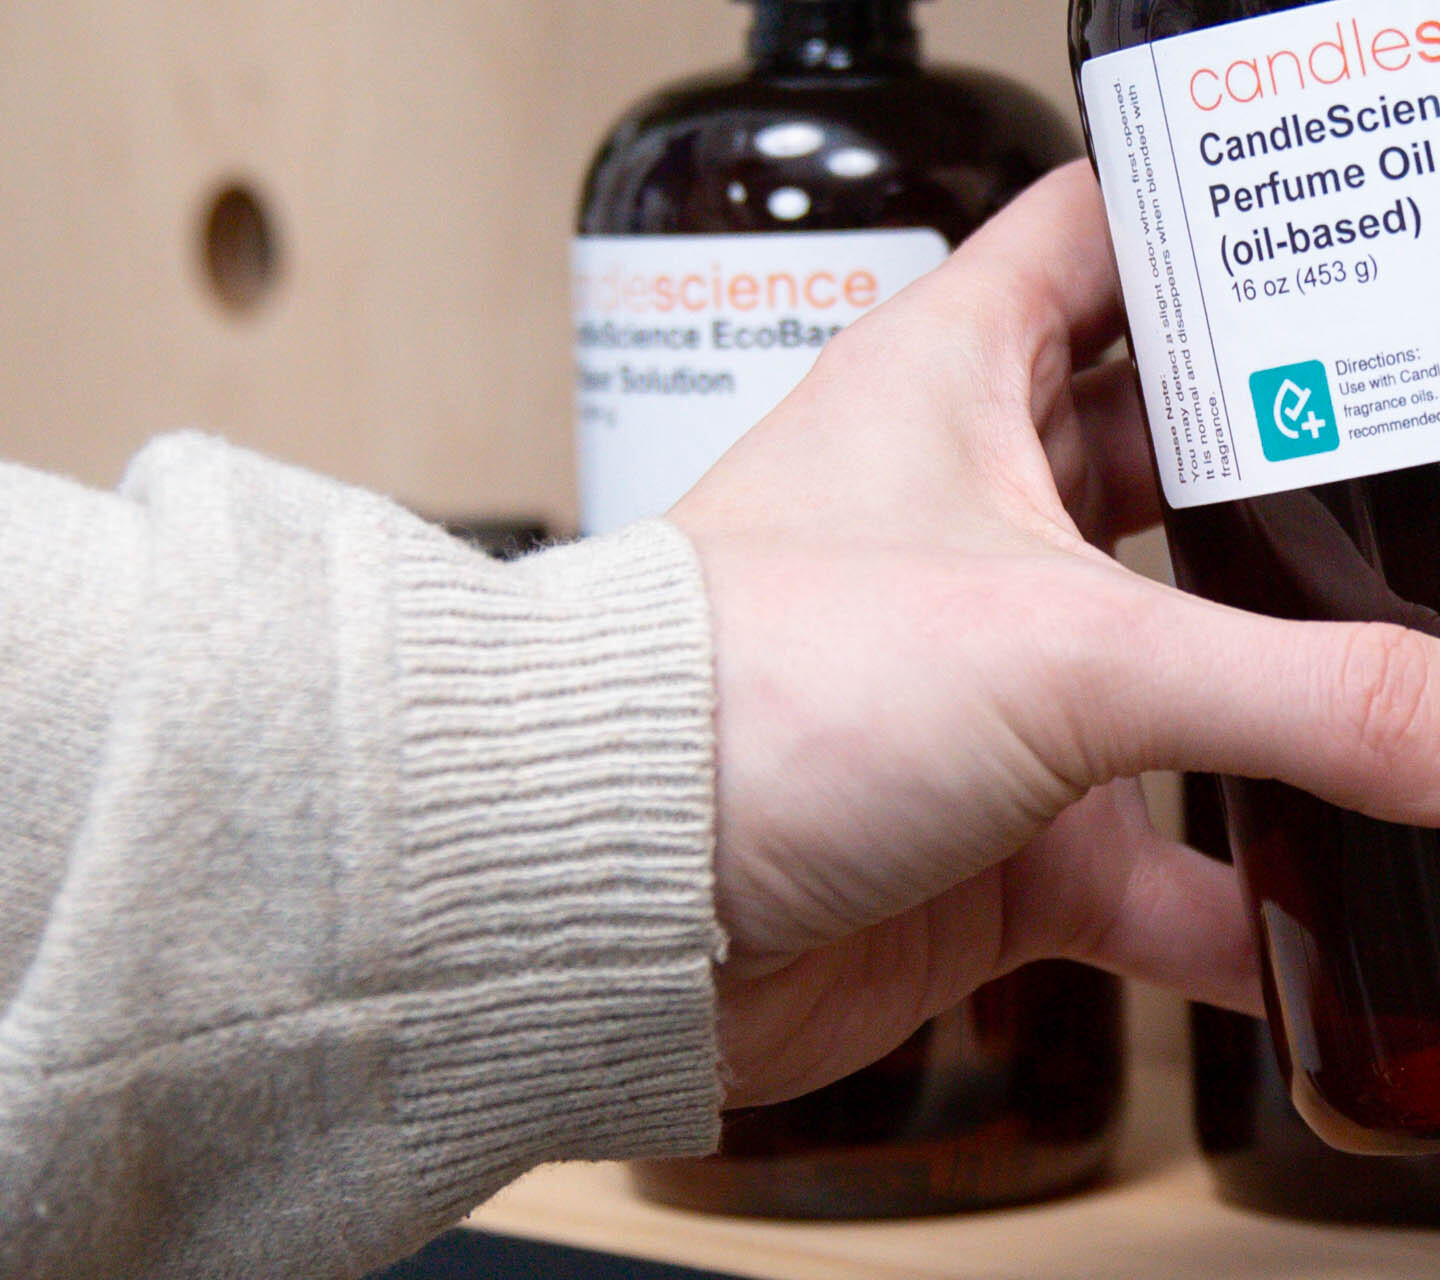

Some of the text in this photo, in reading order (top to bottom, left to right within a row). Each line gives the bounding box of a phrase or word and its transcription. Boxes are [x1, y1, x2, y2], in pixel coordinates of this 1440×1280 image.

[1209, 163, 1365, 217] Perfume
[1379, 140, 1435, 180] Oil
[1221, 196, 1422, 278] (oil-based)
[1114, 77, 1200, 483] You may detect a slight odor when first opened.
[1128, 84, 1216, 480] It is normal and disappears when blended with
[1231, 254, 1378, 302] 16 oz (453 g)
[621, 366, 735, 395] Solution
[1335, 348, 1421, 376] Directions:
[1339, 380, 1366, 396] Use
[1369, 373, 1397, 389] with
[1160, 374, 1187, 484] Please Note:
[1208, 391, 1232, 478] fragrance.
[1344, 396, 1407, 418] fragrance
[1411, 390, 1439, 405] oils.
